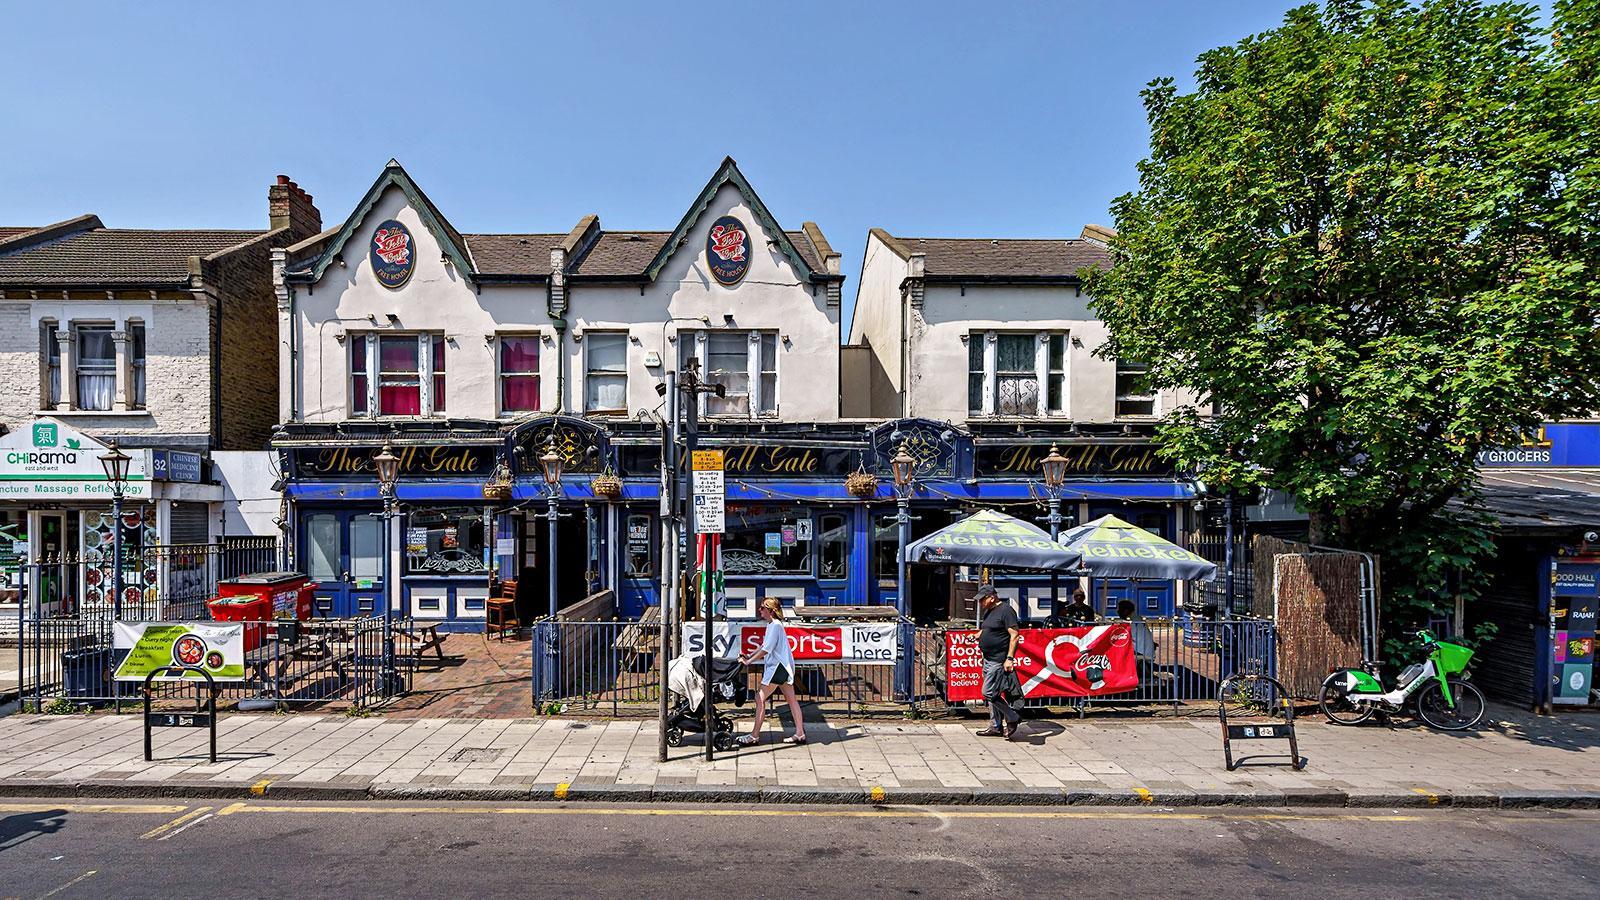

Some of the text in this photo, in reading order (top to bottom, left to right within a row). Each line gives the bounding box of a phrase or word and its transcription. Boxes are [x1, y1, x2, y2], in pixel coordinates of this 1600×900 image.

[37, 427, 54, 444] 氣
[421, 446, 479, 472] Gate
[761, 445, 818, 472] Gate
[994, 445, 1157, 472] The oll Gate
[1489, 451, 1550, 462] GROCERS
[154, 459, 166, 471] 32
[171, 462, 199, 472] MEDICINE
[34, 484, 79, 494] Massage
[1575, 574, 1595, 582] HALL
[1573, 611, 1595, 619] RAJAH
[852, 627, 882, 643] live
[747, 632, 837, 654] sorts
[852, 646, 892, 660] here
[950, 645, 982, 656] foot
[1012, 656, 1032, 667] ere
